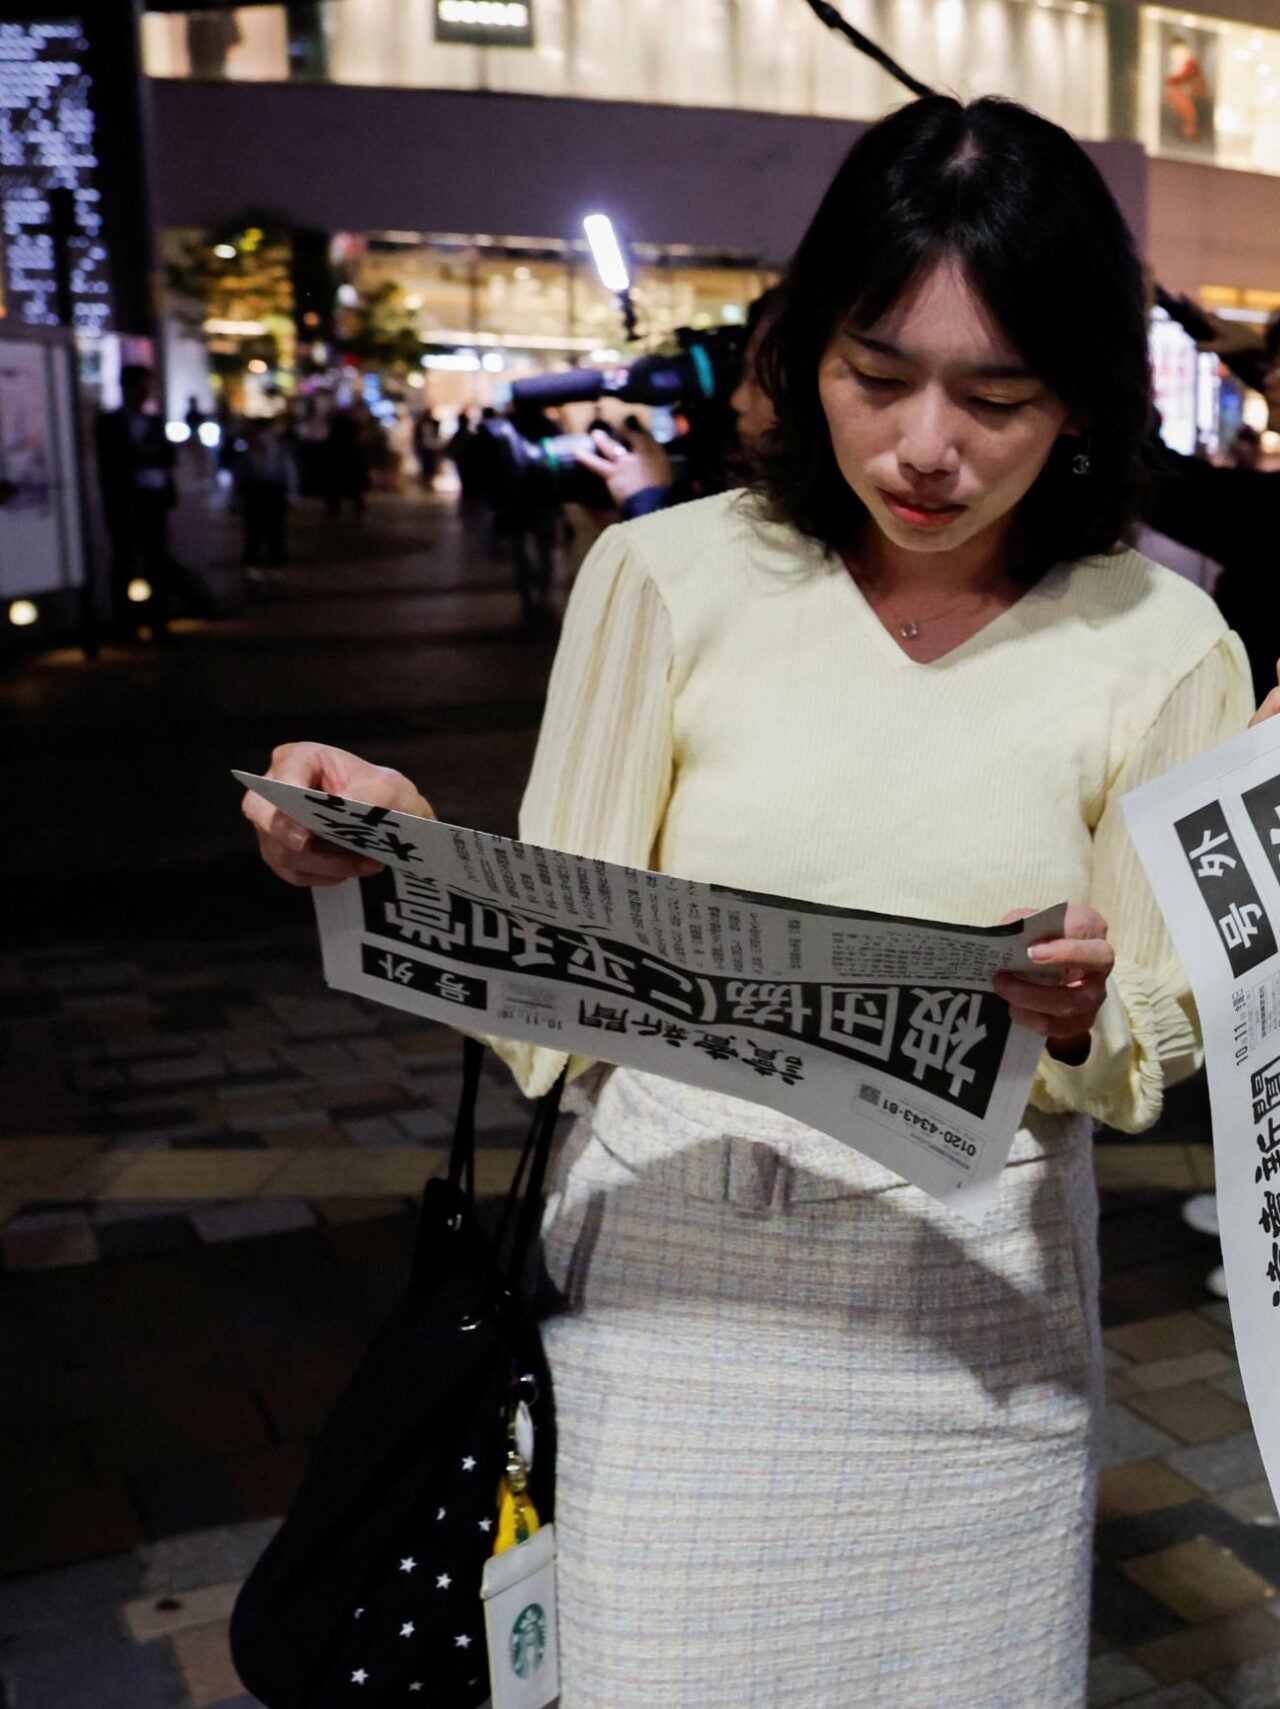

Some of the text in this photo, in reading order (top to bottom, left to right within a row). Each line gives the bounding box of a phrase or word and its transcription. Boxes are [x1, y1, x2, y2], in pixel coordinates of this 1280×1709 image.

[1189, 829, 1263, 949] 号外
[377, 953, 470, 1002] 号外
[384, 871, 987, 1097] 被団協に平和賞
